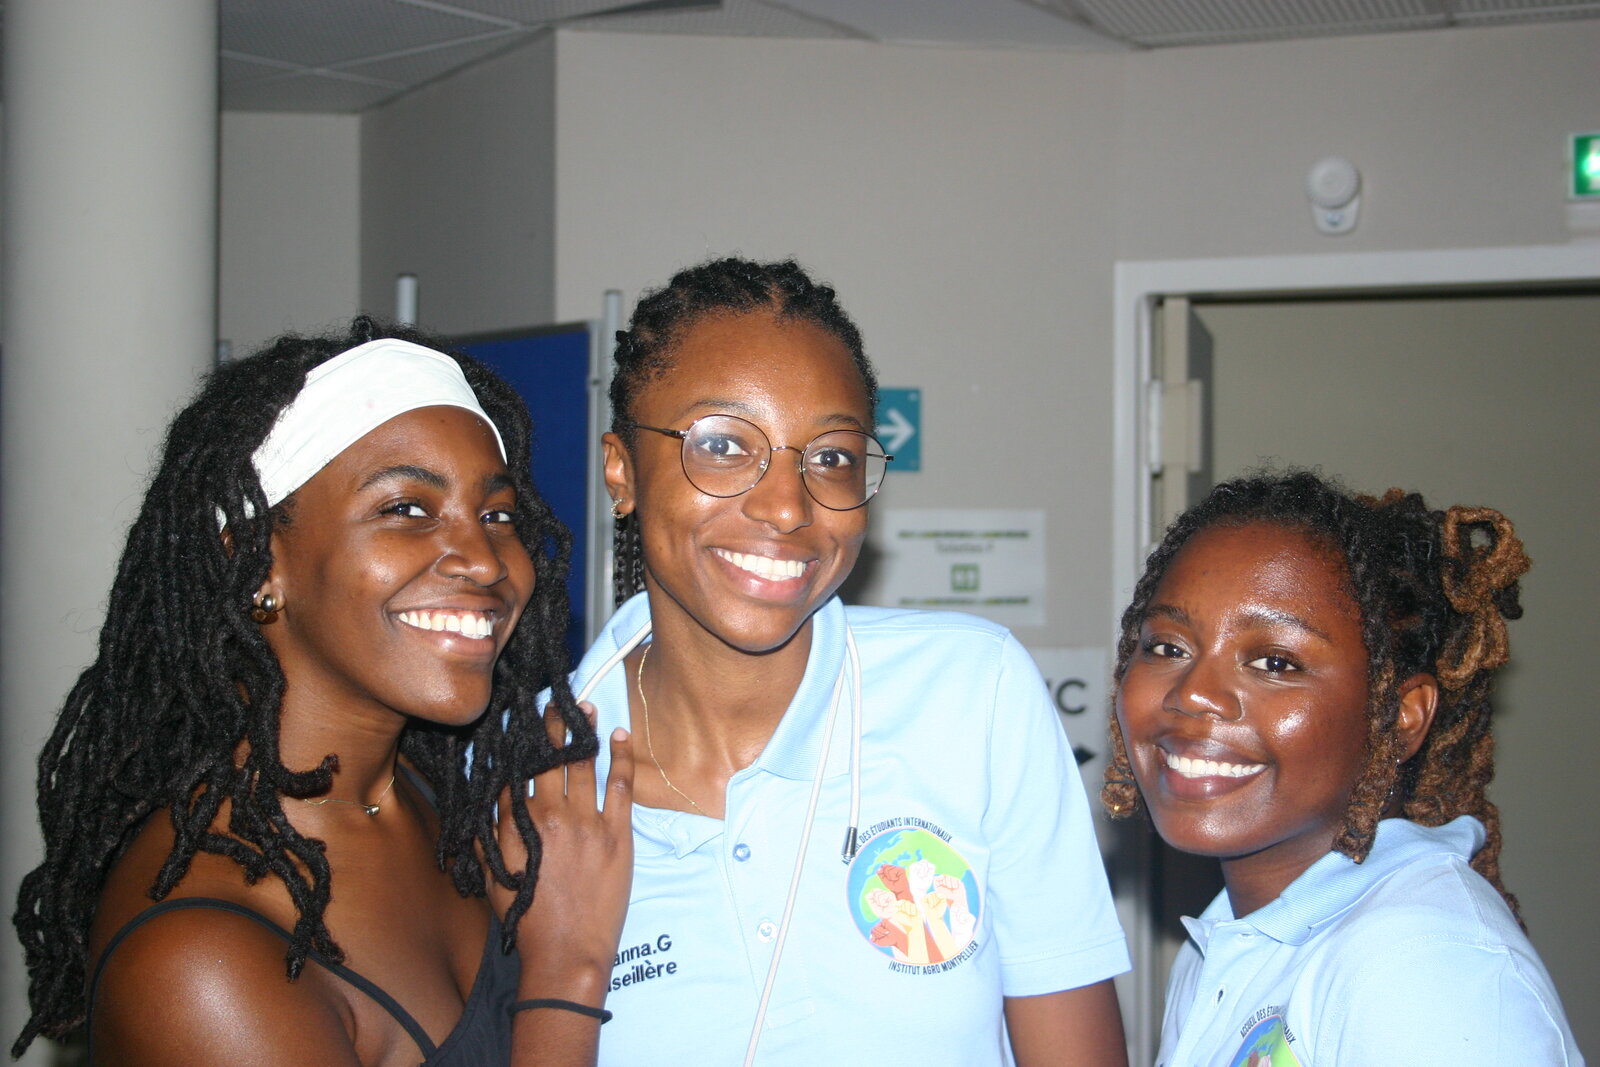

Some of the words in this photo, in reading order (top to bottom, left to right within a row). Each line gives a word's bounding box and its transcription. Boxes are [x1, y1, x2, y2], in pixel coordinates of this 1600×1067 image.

[1046, 678, 1088, 715] C
[859, 830, 872, 844] DES
[903, 817, 953, 844] INTERNATIONAUX
[888, 960, 921, 976] INSTITUT
[922, 964, 941, 976] AGRO
[941, 940, 980, 972] MONTPELLIER
